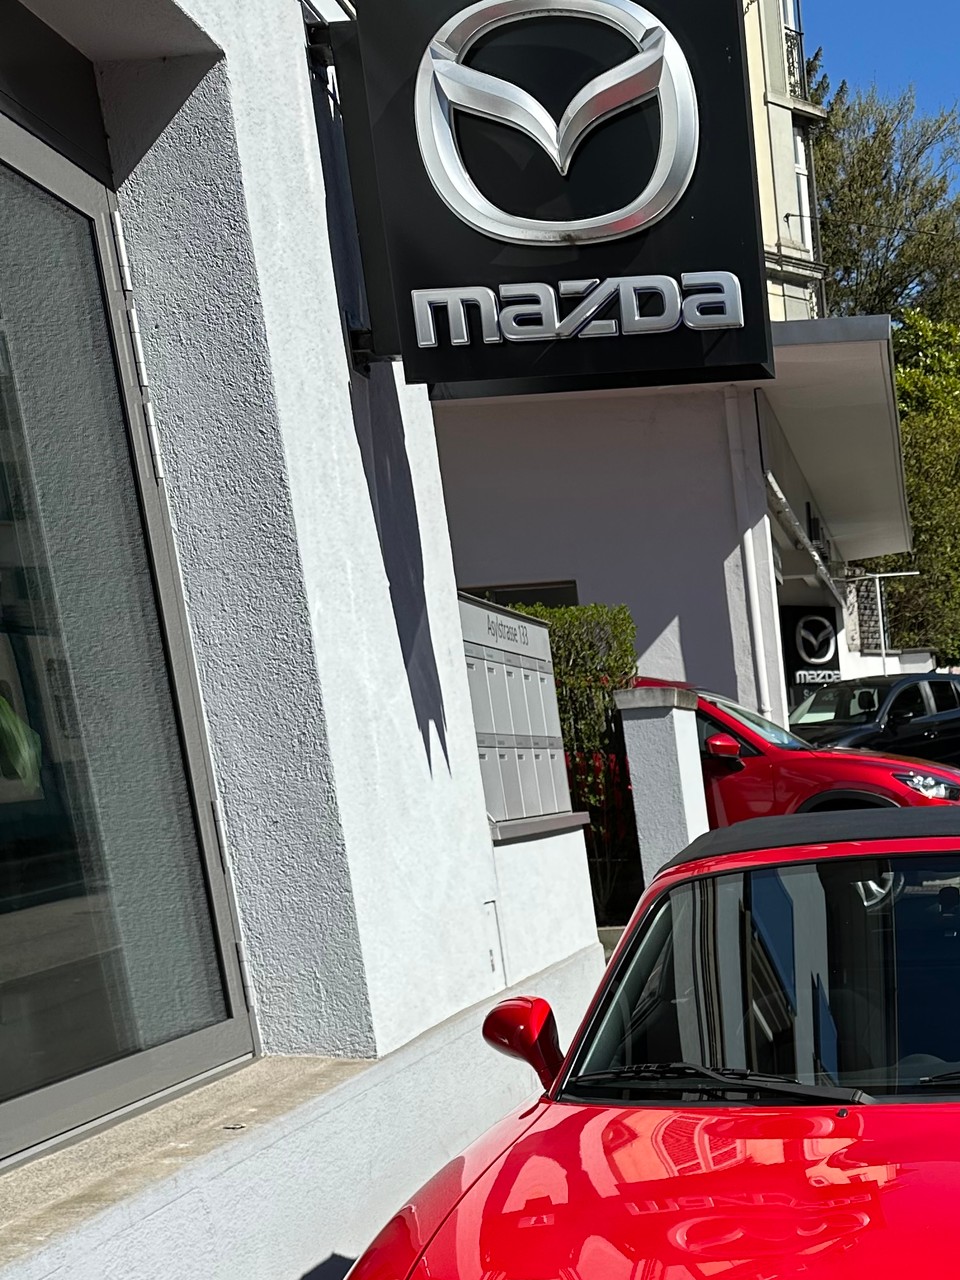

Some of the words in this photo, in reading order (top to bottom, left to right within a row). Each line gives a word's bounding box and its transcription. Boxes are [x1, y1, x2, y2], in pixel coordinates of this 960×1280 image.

[411, 271, 744, 348] mazda
[487, 614, 518, 643] Asylstrasse
[518, 625, 529, 646] 133
